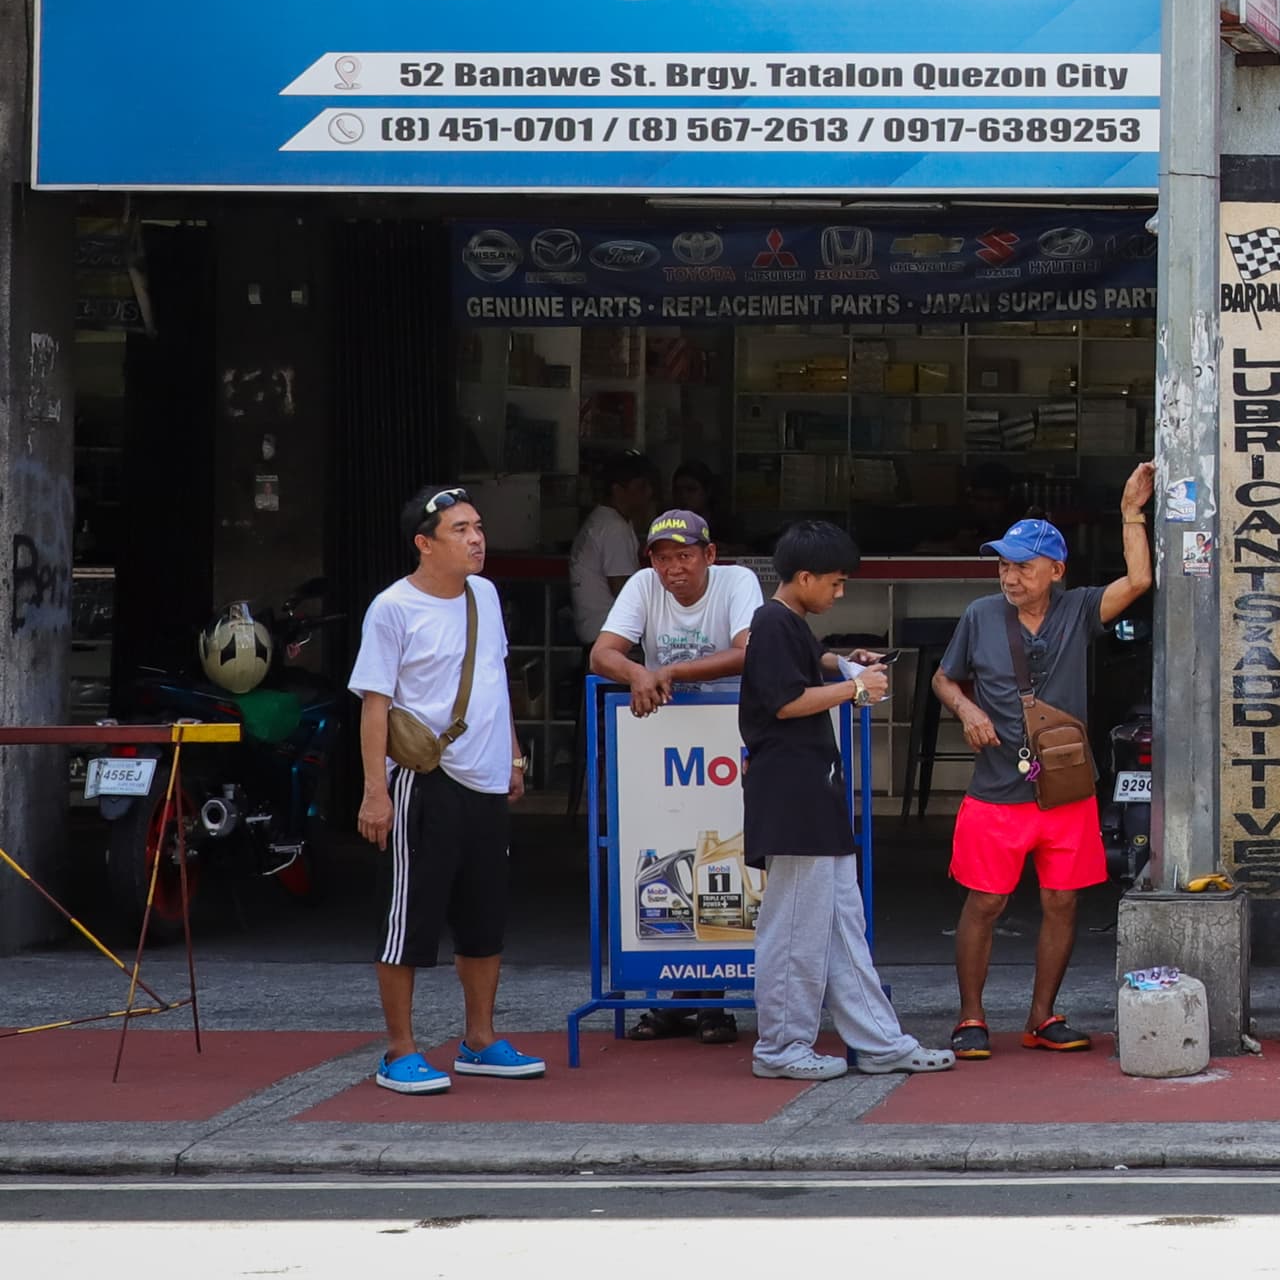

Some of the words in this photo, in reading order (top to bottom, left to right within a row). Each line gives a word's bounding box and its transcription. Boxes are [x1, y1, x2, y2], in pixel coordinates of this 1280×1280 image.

[399, 62, 444, 88] 52
[454, 62, 601, 88] Banawe
[610, 62, 656, 88] St.
[666, 62, 757, 91] Brgy.
[766, 62, 903, 88] Tatalon
[912, 62, 1047, 90] Quezon
[1056, 62, 1129, 91] City
[381, 117, 430, 143] (8)
[438, 117, 593, 143] 451-0701
[602, 117, 618, 143] /
[628, 117, 677, 143] (8)
[687, 117, 849, 143] 567-2613
[858, 117, 874, 143] /
[883, 117, 1141, 144] 0917-6389253
[664, 266, 737, 282] TOYOTA
[814, 269, 880, 281] HONDA
[466, 296, 565, 319] GENUINE
[572, 296, 642, 319] PARTS
[661, 293, 823, 318] REPLACEMENT
[831, 292, 901, 316] PARTS
[920, 291, 990, 315] JAPAN
[998, 288, 1097, 314] SURPLUS
[707, 865, 731, 873] Mobil
[658, 963, 755, 981] AVAILABLE
